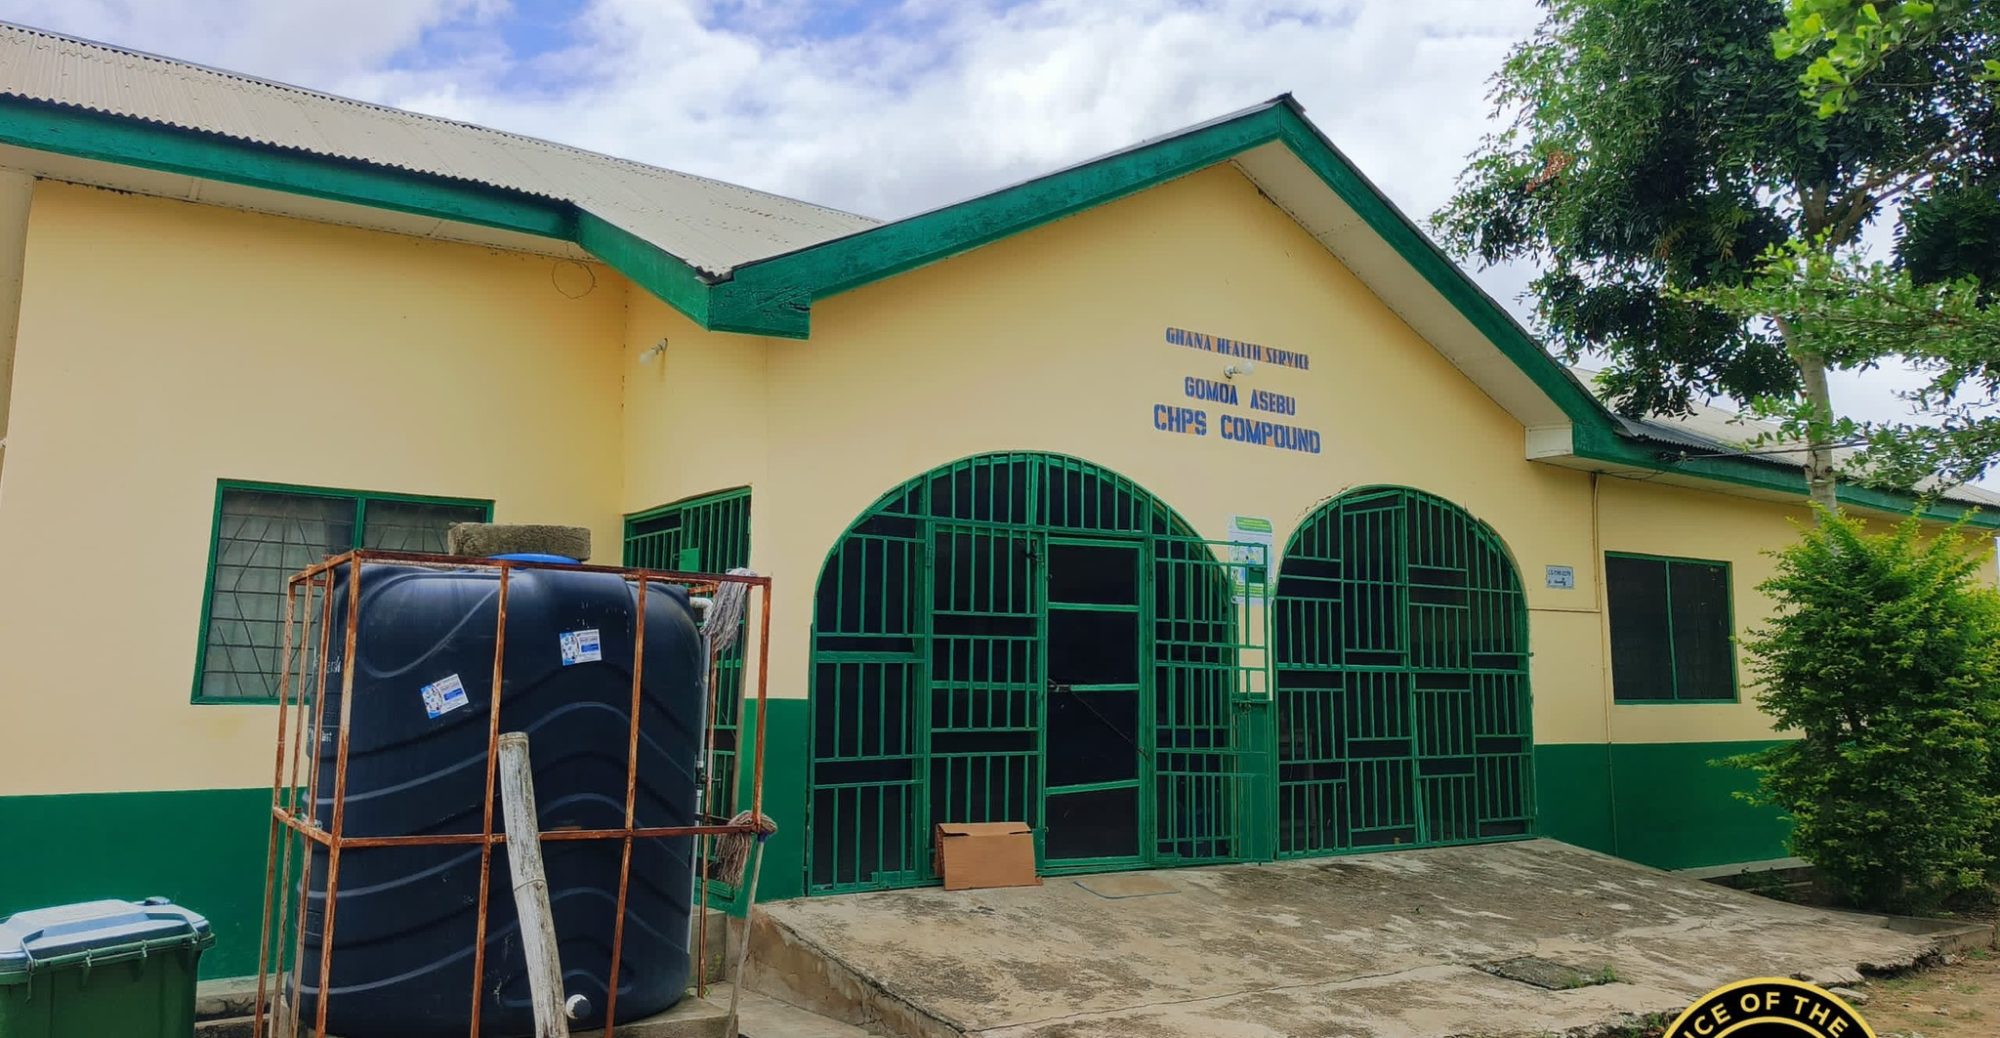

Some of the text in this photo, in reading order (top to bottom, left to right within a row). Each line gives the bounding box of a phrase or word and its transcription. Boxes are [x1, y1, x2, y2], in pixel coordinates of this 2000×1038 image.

[1165, 327, 1310, 370] GHANA HEALTH SERVICE
[1184, 376, 1296, 416] GOMOA ASEBU
[1153, 404, 1321, 454] CHPS COMPOUND
